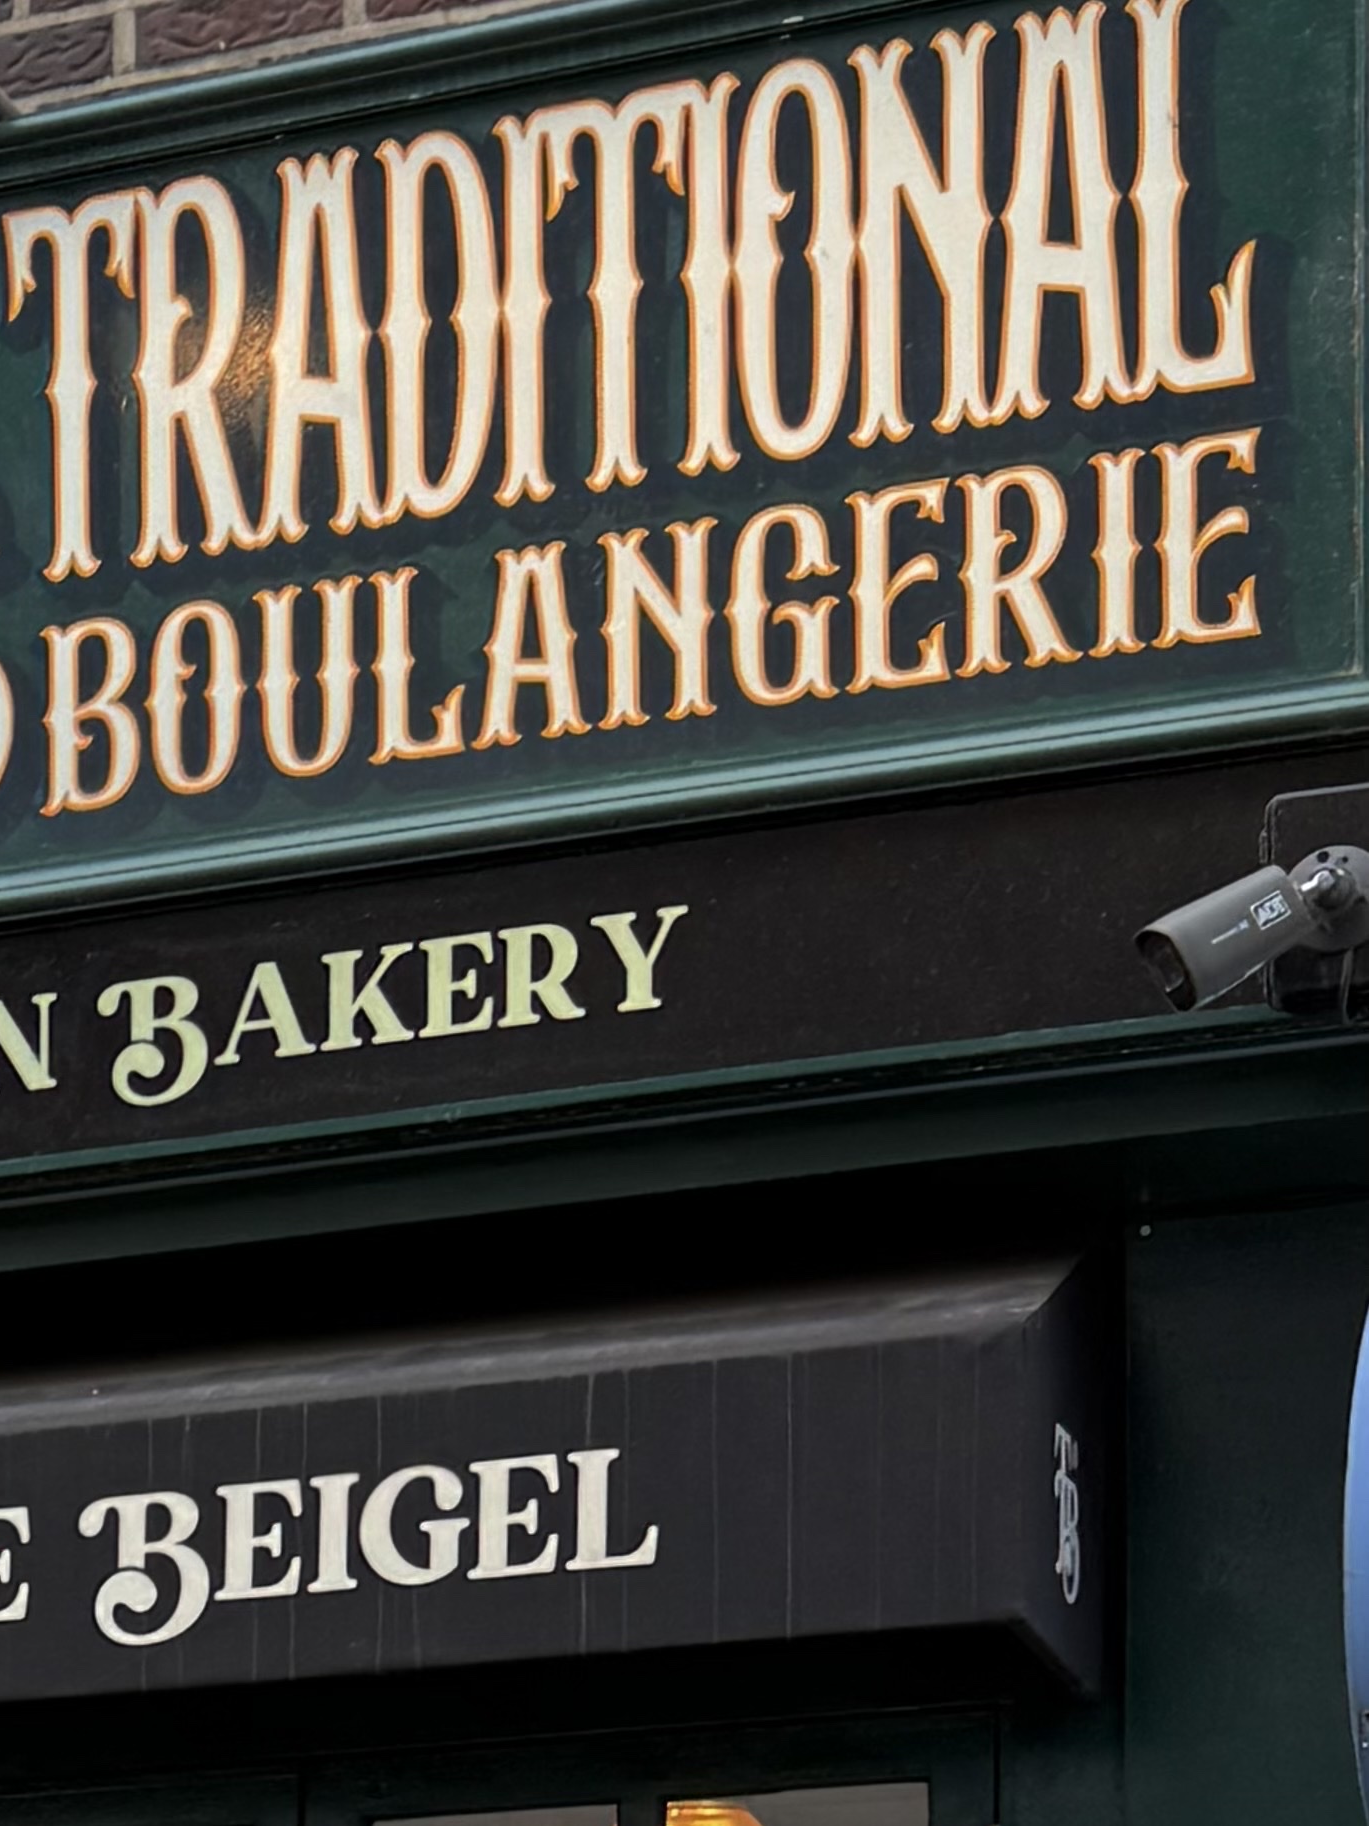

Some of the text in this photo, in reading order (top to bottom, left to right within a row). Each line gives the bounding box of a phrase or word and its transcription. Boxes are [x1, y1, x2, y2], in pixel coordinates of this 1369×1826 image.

[2, 0, 1258, 582] TRADITIONAL
[40, 426, 1262, 816] BOULANGERIE
[97, 905, 689, 1107] BAKERY
[78, 1448, 659, 1647] BEIGEL
